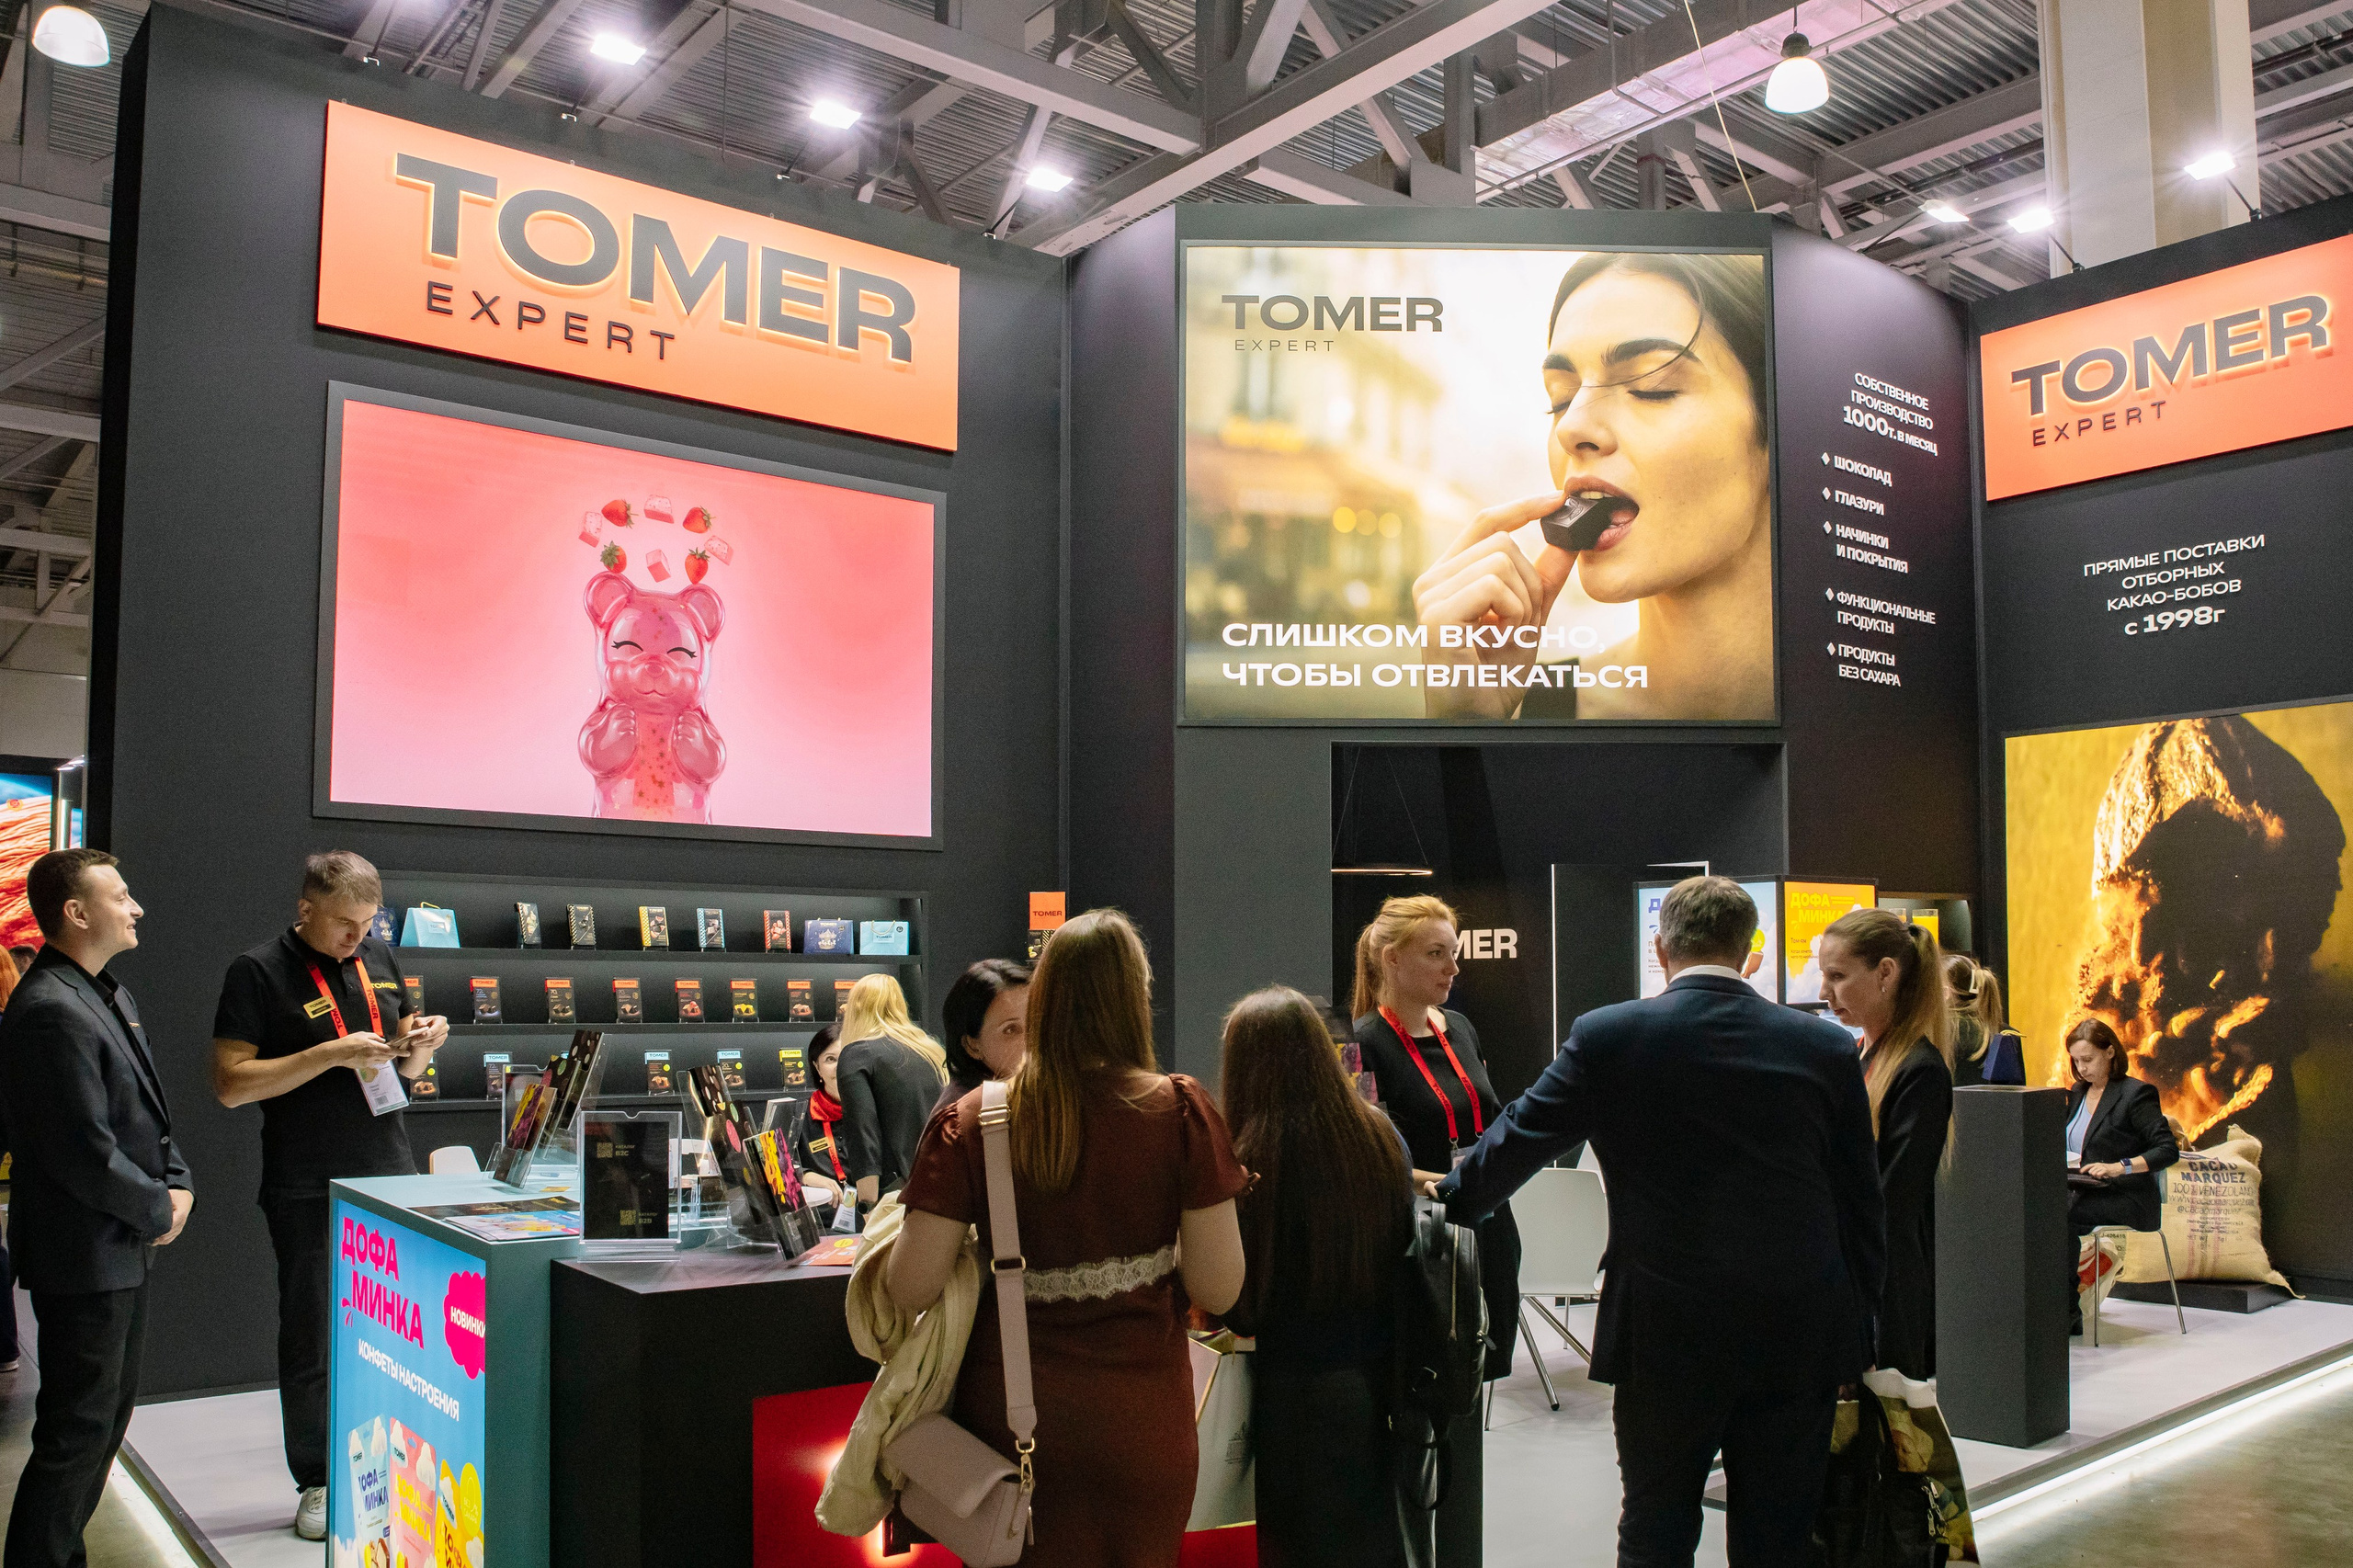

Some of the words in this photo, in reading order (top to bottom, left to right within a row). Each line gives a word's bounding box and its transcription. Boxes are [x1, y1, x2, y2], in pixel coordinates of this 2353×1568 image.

[396, 153, 915, 363] TOMER
[427, 281, 675, 359] EXPERT
[1222, 294, 1444, 333] TOMER
[1234, 339, 1335, 352] EXPERT
[2011, 294, 2329, 416] TOMER
[1854, 372, 1929, 411] СОБСТВЕННОЕ
[1851, 390, 1934, 430] ПРОИЗВОДСТВО
[2032, 399, 2166, 448] EXPERT
[1834, 456, 1893, 487] ШОКОЛАД
[1835, 489, 1884, 516] ГЛАЗУРИ
[1836, 524, 1889, 549] НАЧИНКИ
[1836, 544, 1845, 557] И
[1847, 547, 1908, 574] ПОКРЫТИЯ
[2084, 553, 2160, 576] ПРЯМЫЕ
[2164, 534, 2265, 562] ПОСТАВКИ
[2121, 562, 2225, 589] ОТБОРНЫХ
[1836, 591, 1936, 624] ФУНКЦИОНАЛЬНЫЕ
[2107, 579, 2242, 611] КАКАО-БОБОВ
[1837, 611, 1894, 635] ПРОДУКТЫ
[2143, 606, 2225, 633] 1998г
[1222, 623, 1428, 648] СЛИШКОМ
[1439, 623, 1606, 653] ВКУСНО,
[1838, 644, 1895, 666] ПРОДУКТЫ
[1222, 663, 1361, 687] ЧТОБЫ
[1371, 664, 1648, 688] ОТВЛЕКАТЬСЯ
[1838, 665, 1859, 680] БЕЗ
[1859, 667, 1901, 687] САХАРА
[1790, 892, 1830, 908] ДОФА
[309, 999, 326, 1009] TOMER
[331, 1008, 344, 1029] TOM
[366, 989, 379, 1019] TOMER
[2180, 1171, 2245, 1185] MARQUEZ
[341, 1216, 400, 1281] ДОФА
[351, 1269, 424, 1350] МИНКА
[358, 1337, 398, 1378] КОНФЕТЫ
[399, 1366, 460, 1422] НАСТРОЕНИЯ
[393, 1447, 405, 1461] TOMER
